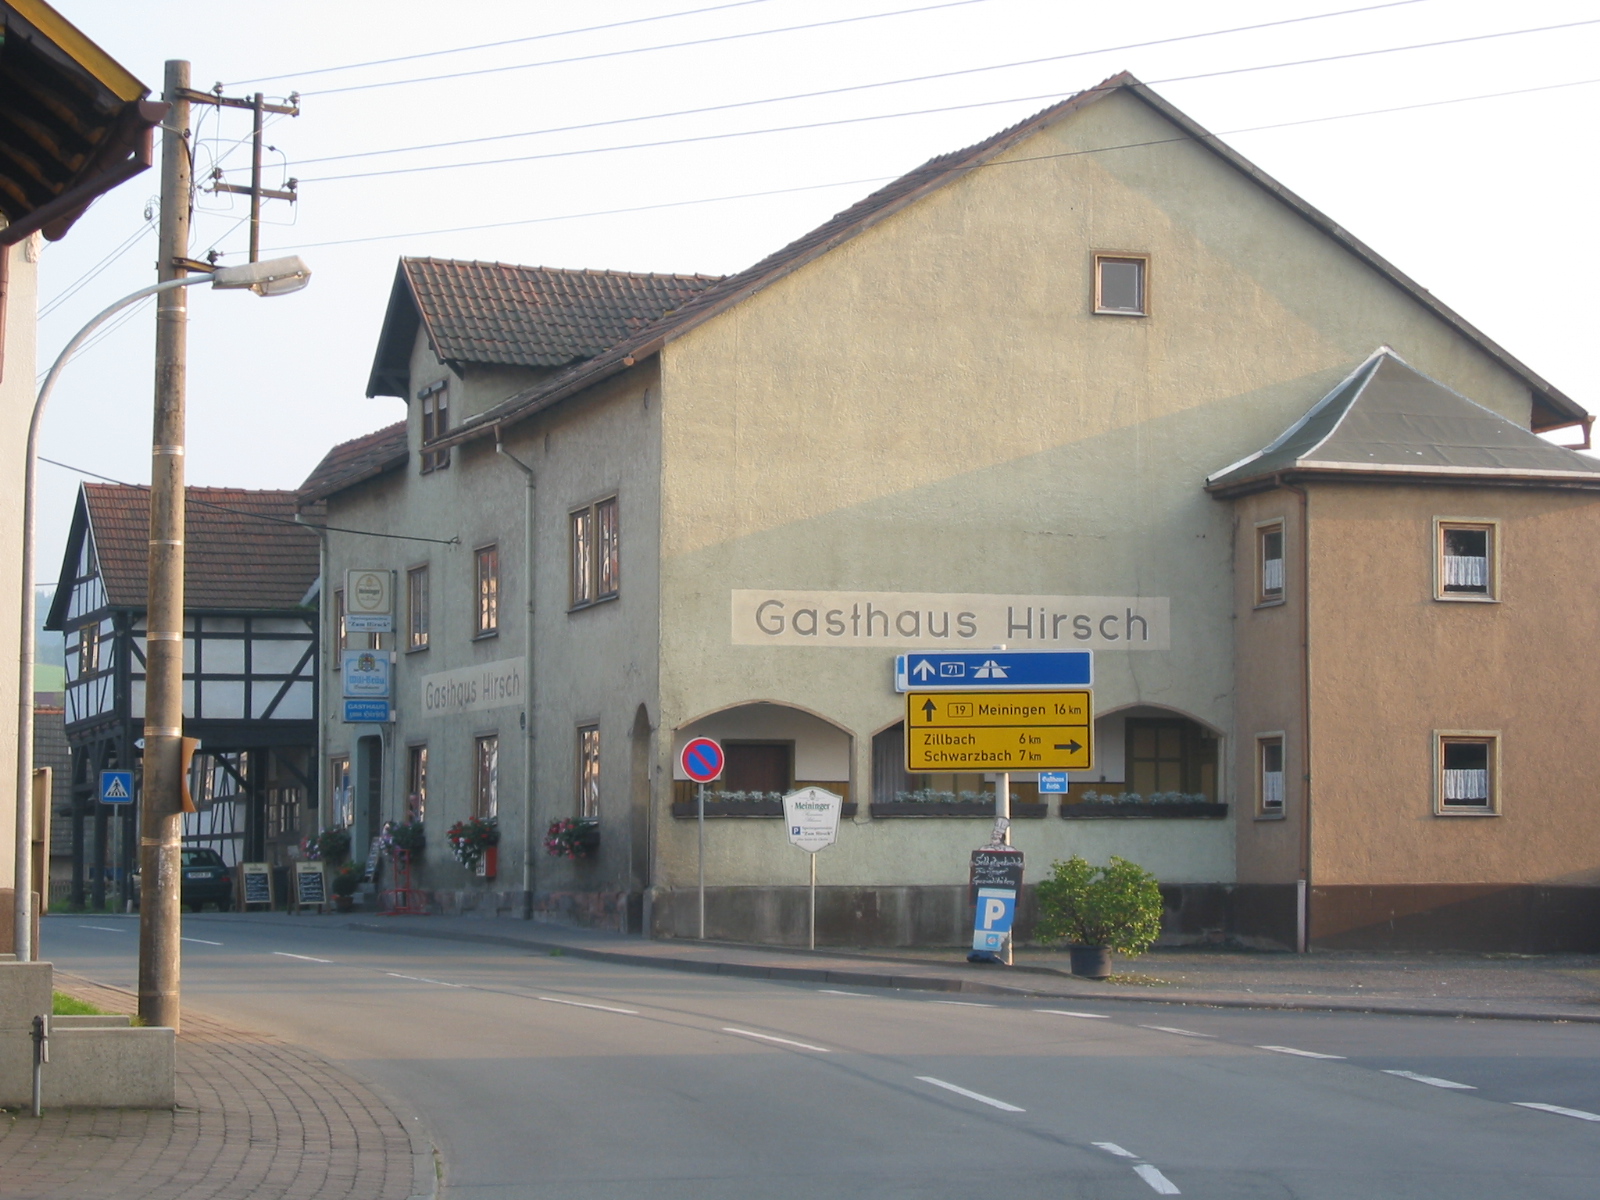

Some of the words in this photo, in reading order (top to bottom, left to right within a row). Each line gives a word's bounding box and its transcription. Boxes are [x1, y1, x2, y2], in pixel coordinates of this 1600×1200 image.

[755, 599, 977, 639] Gasthaus
[1006, 605, 1149, 641] Hirsch
[947, 665, 958, 674] 71
[425, 678, 477, 711] Gasthaus
[482, 667, 520, 702] Hirsch
[955, 705, 966, 715] 19
[978, 704, 1046, 718] Meiningen
[1054, 703, 1066, 715] 16
[1068, 705, 1082, 715] km
[924, 733, 976, 746] Zillbach
[1019, 733, 1026, 745] 6
[1028, 735, 1042, 745] km
[924, 750, 1012, 763] Schwarzbach
[1019, 750, 1026, 762] 7
[1028, 751, 1042, 762] km
[795, 802, 830, 811] Meininger
[984, 899, 1005, 929] P
